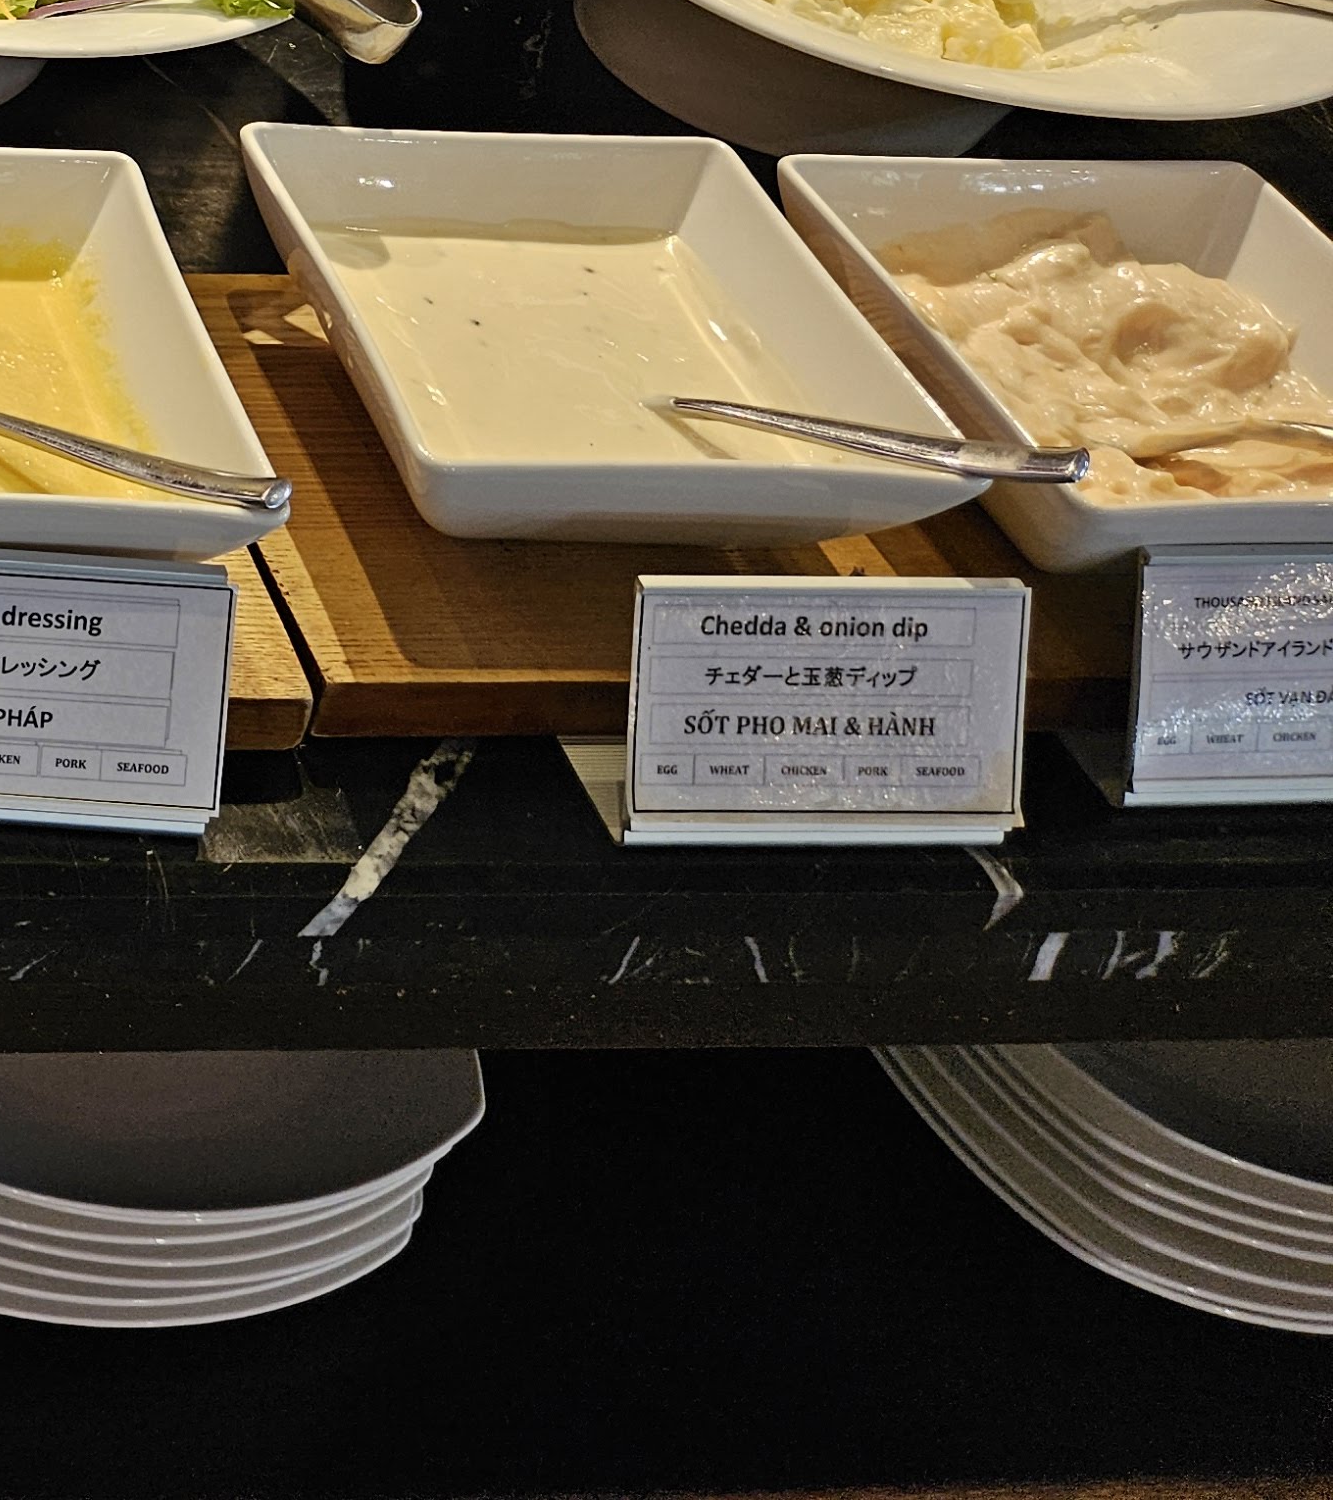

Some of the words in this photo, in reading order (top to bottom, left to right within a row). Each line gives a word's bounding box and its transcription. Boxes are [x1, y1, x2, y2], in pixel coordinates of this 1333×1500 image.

[2, 605, 103, 637] dressing
[700, 615, 786, 637] Chedda
[794, 617, 812, 636] &
[820, 618, 884, 637] onion
[892, 617, 928, 641] dip
[704, 666, 918, 688] チェダーと玉葱ディップ
[684, 709, 730, 735] SỐT
[736, 716, 785, 735] PHO
[793, 716, 837, 736] MAI
[844, 718, 861, 736] &
[868, 712, 935, 737] HÀNH
[55, 757, 87, 770] PORK
[116, 761, 169, 775] SEAFOOD
[657, 765, 678, 775] EGG
[710, 765, 749, 776] WHEAT
[781, 765, 827, 776] CHICKEN
[858, 766, 888, 777] PORK
[915, 766, 965, 777] SEAFOOD
